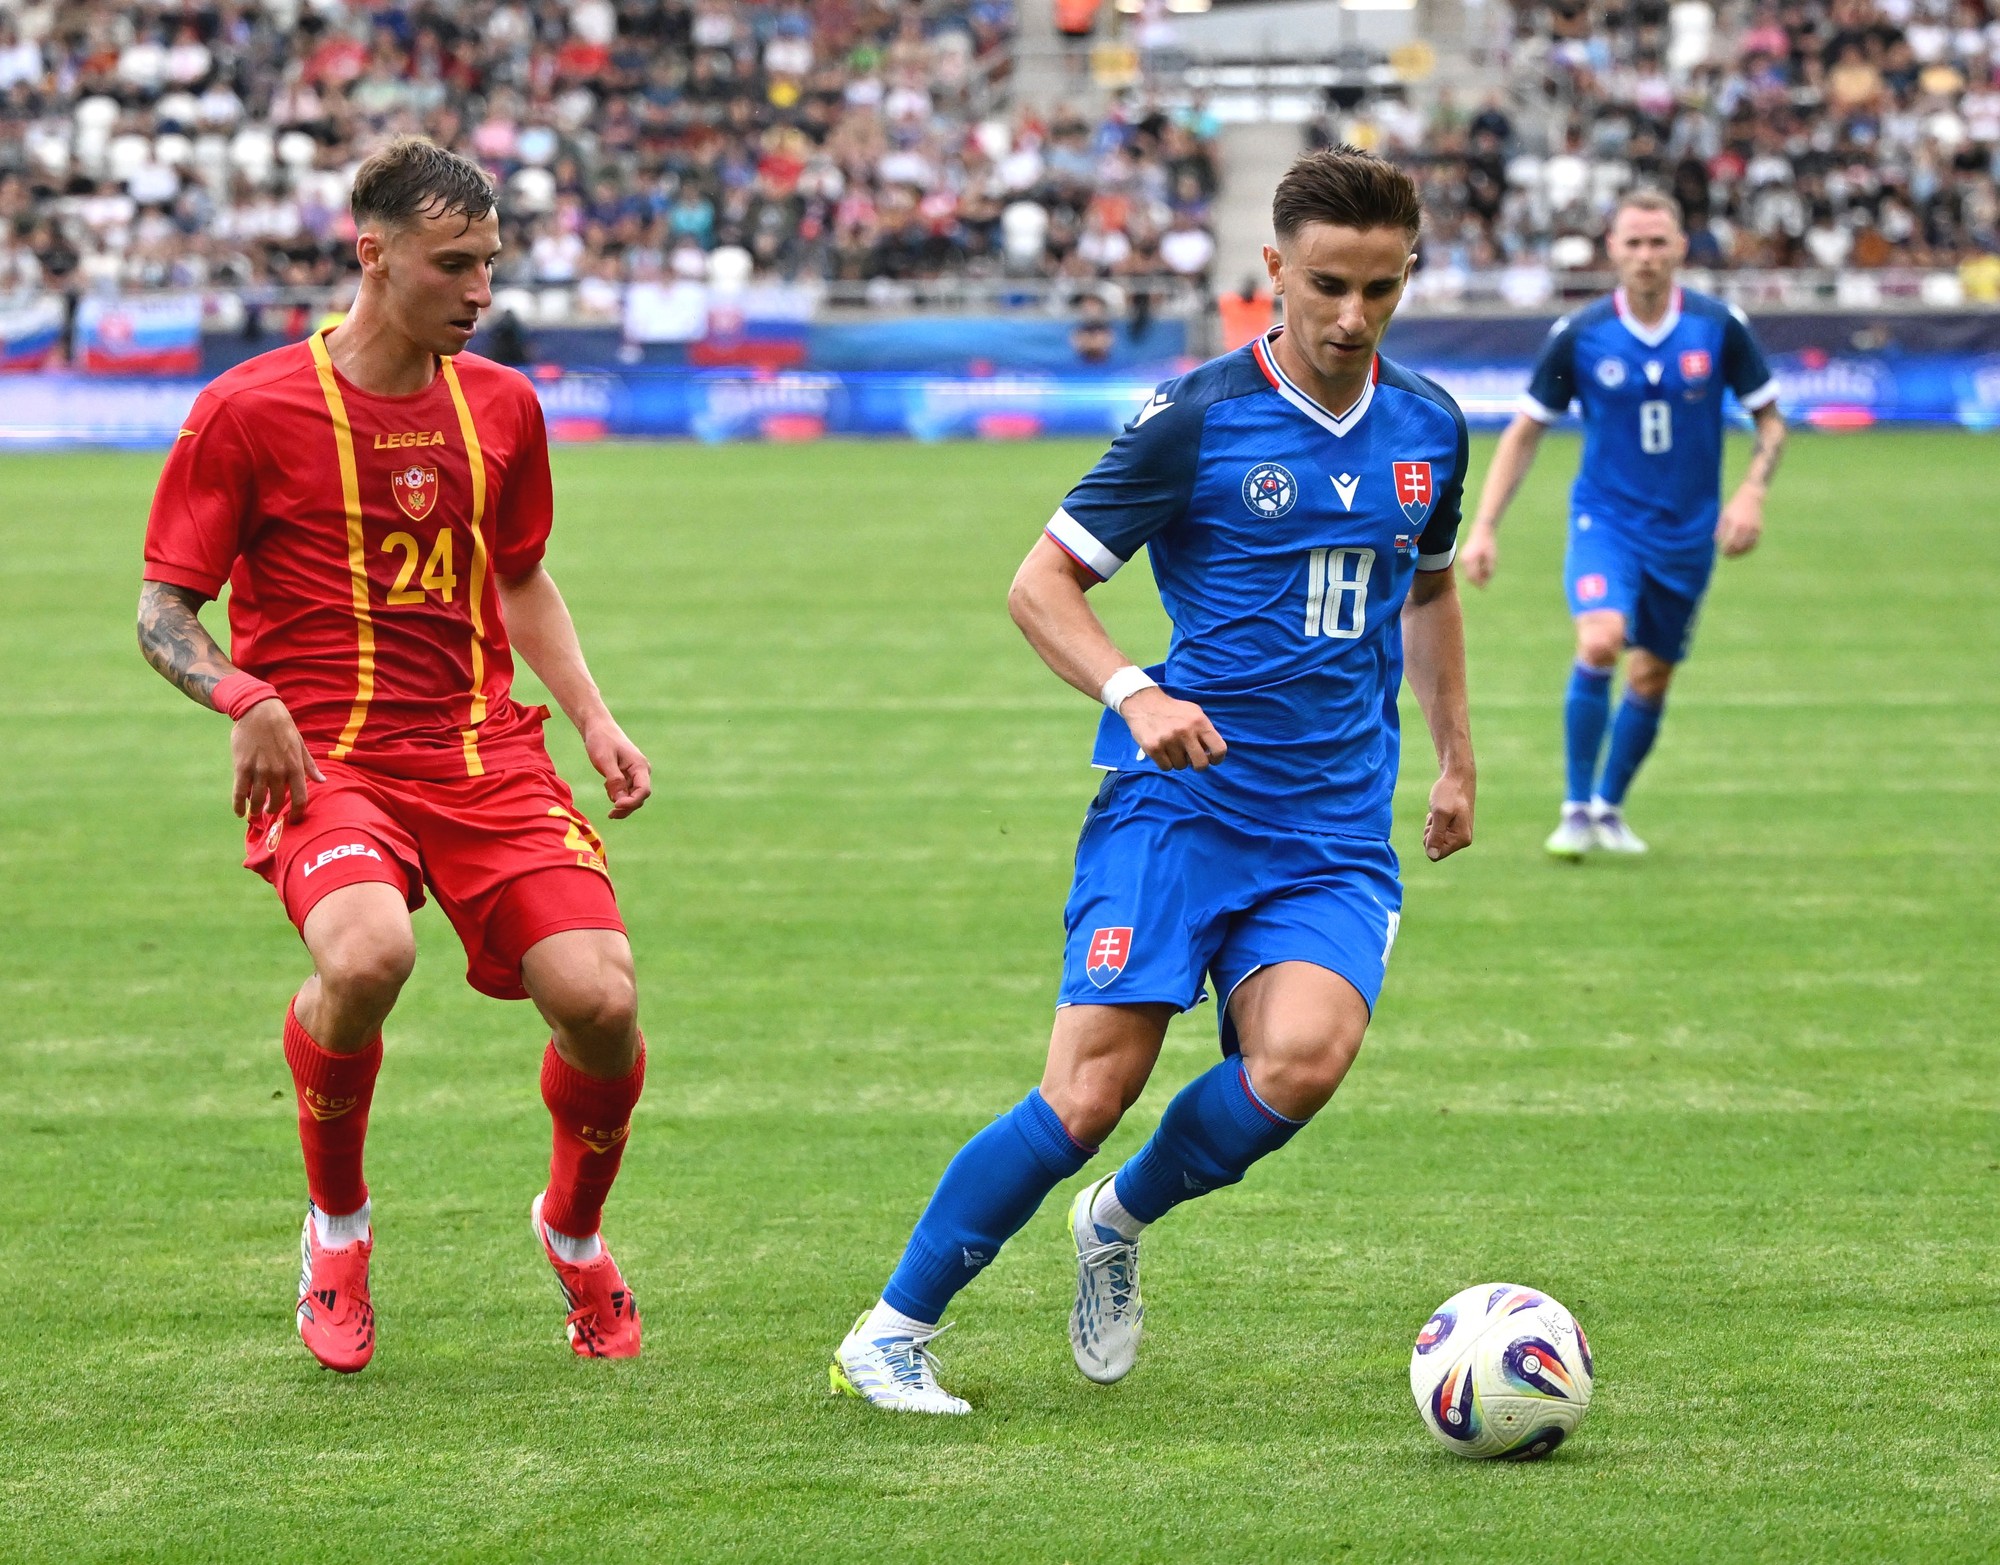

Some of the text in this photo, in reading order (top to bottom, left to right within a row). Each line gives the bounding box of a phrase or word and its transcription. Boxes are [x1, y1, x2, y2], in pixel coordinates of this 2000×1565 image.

[373, 431, 445, 449] LEGEA
[1640, 400, 1672, 454] 8
[395, 472, 435, 486] FS CG
[381, 528, 456, 605] 24
[1305, 547, 1376, 639] 18
[303, 843, 383, 878] LEGEA
